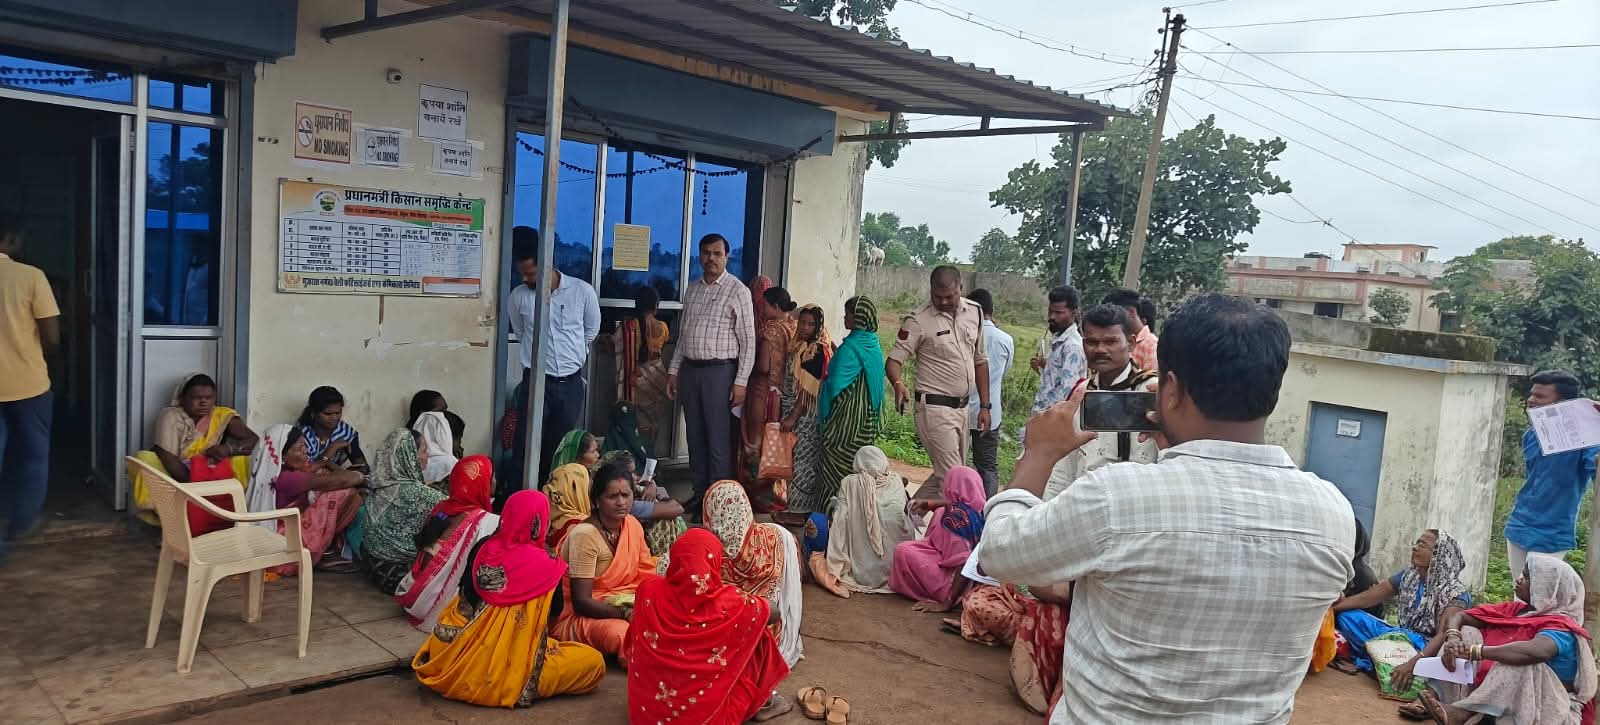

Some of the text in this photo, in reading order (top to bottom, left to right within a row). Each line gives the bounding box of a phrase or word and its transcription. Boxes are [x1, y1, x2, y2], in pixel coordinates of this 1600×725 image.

[420, 99, 466, 112] कृपया शांति
[313, 138, 349, 157] NO SMOKING
[344, 189, 388, 204] प्रधानमंत्री
[390, 191, 422, 207] किसान
